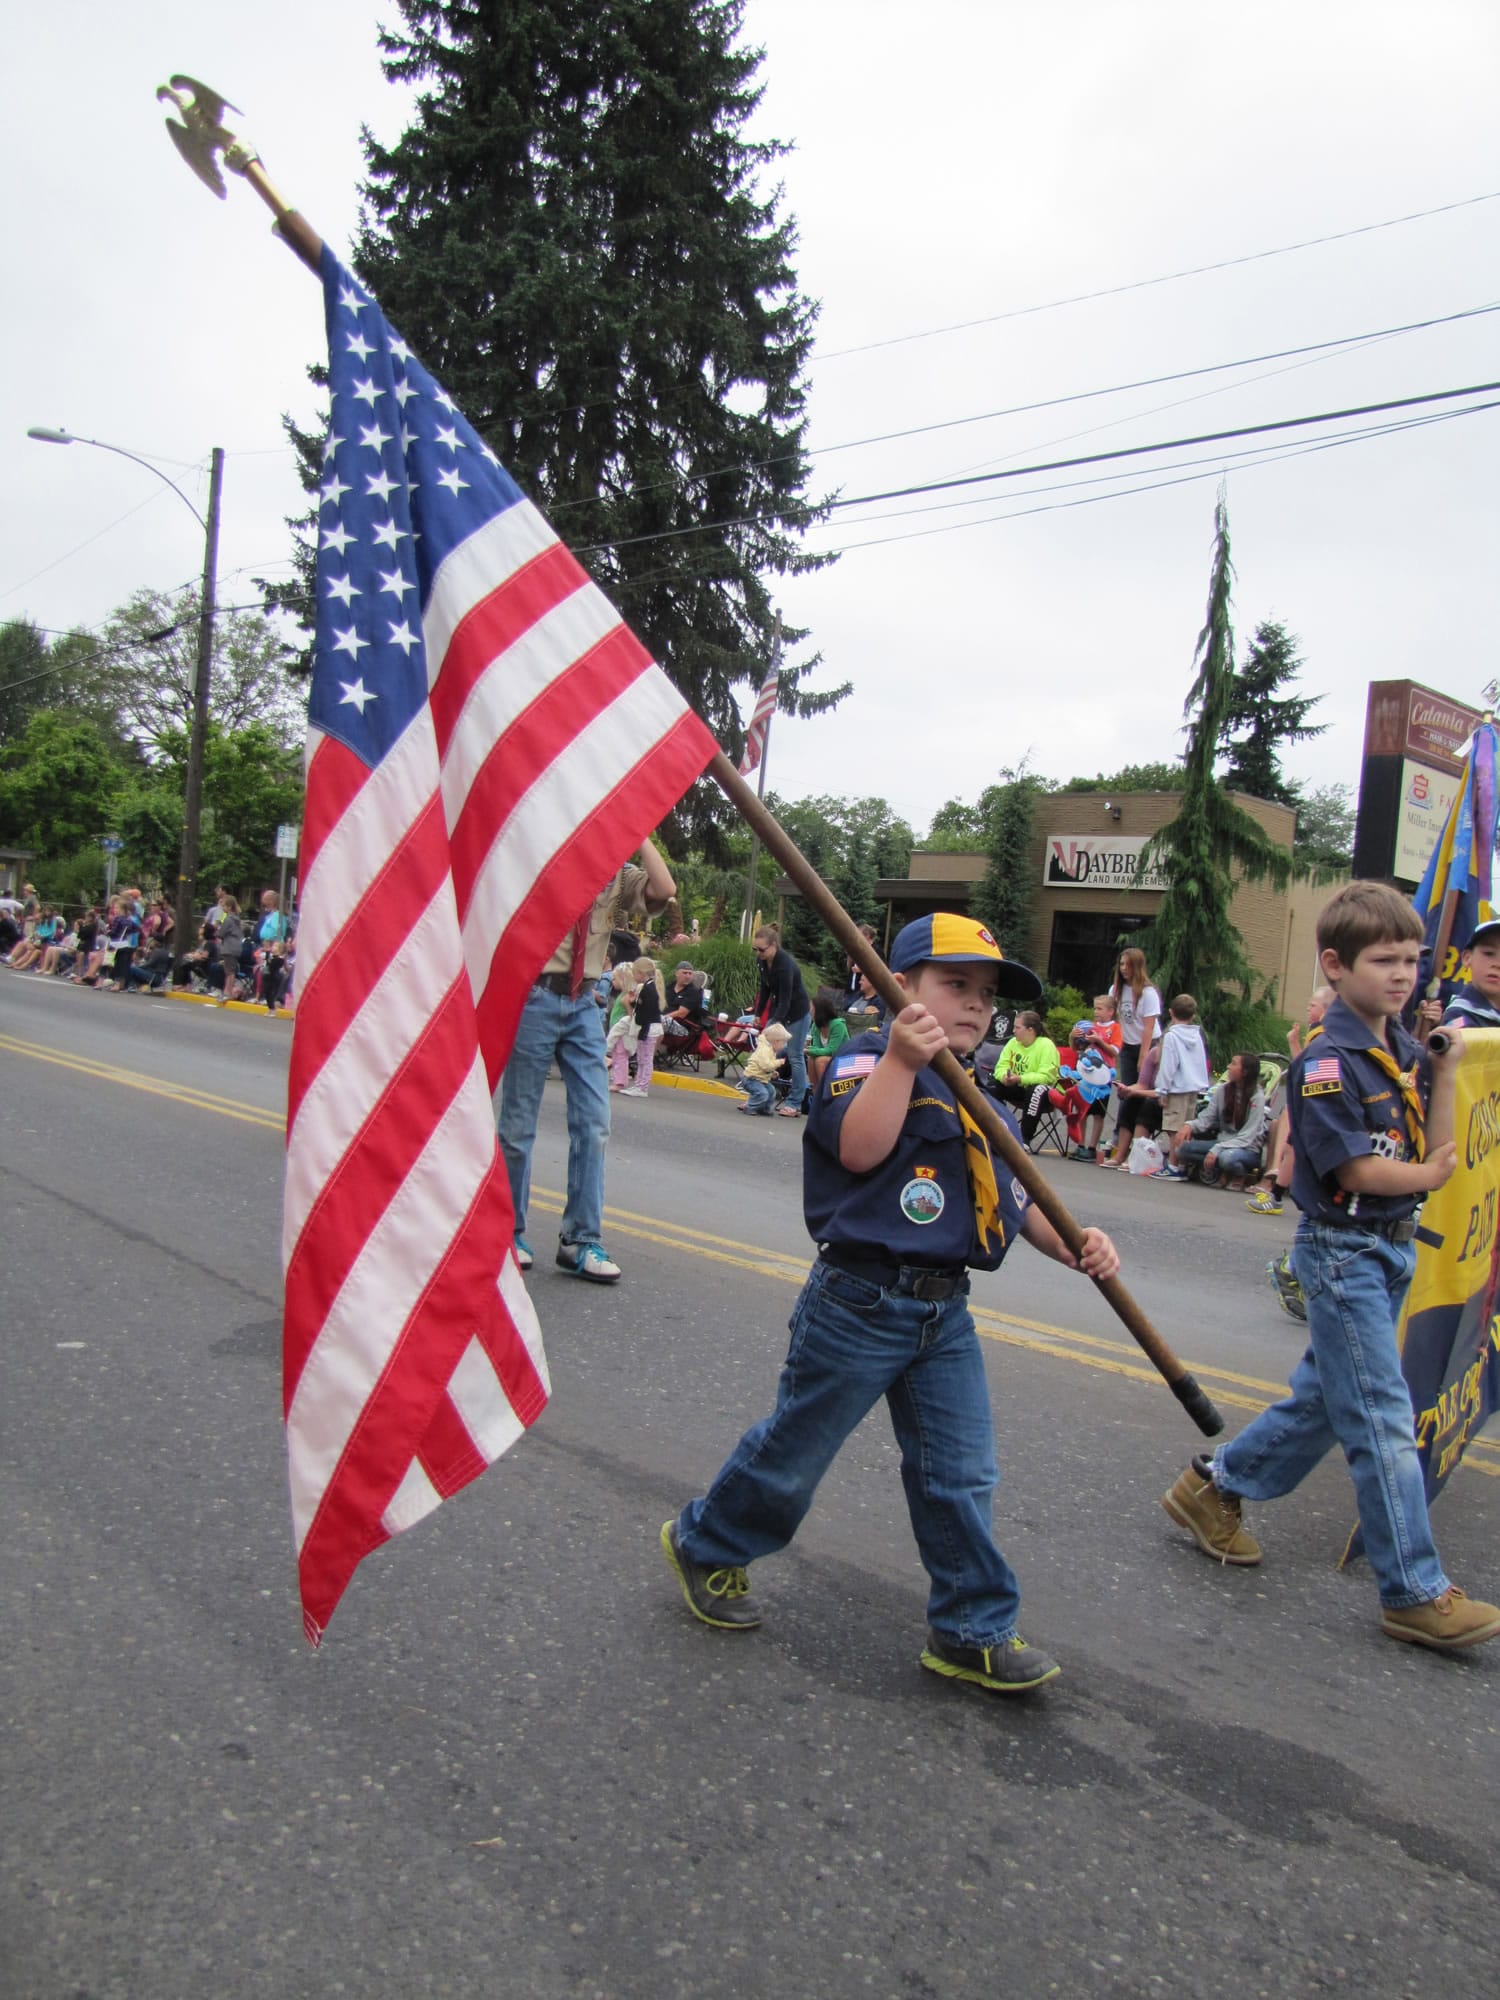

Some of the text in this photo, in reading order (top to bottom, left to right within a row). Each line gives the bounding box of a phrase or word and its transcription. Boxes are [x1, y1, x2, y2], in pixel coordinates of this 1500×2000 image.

[1088, 875, 1110, 884] LAND
[837, 1080, 856, 1092] DEN
[1308, 1083, 1323, 1094] DEN
